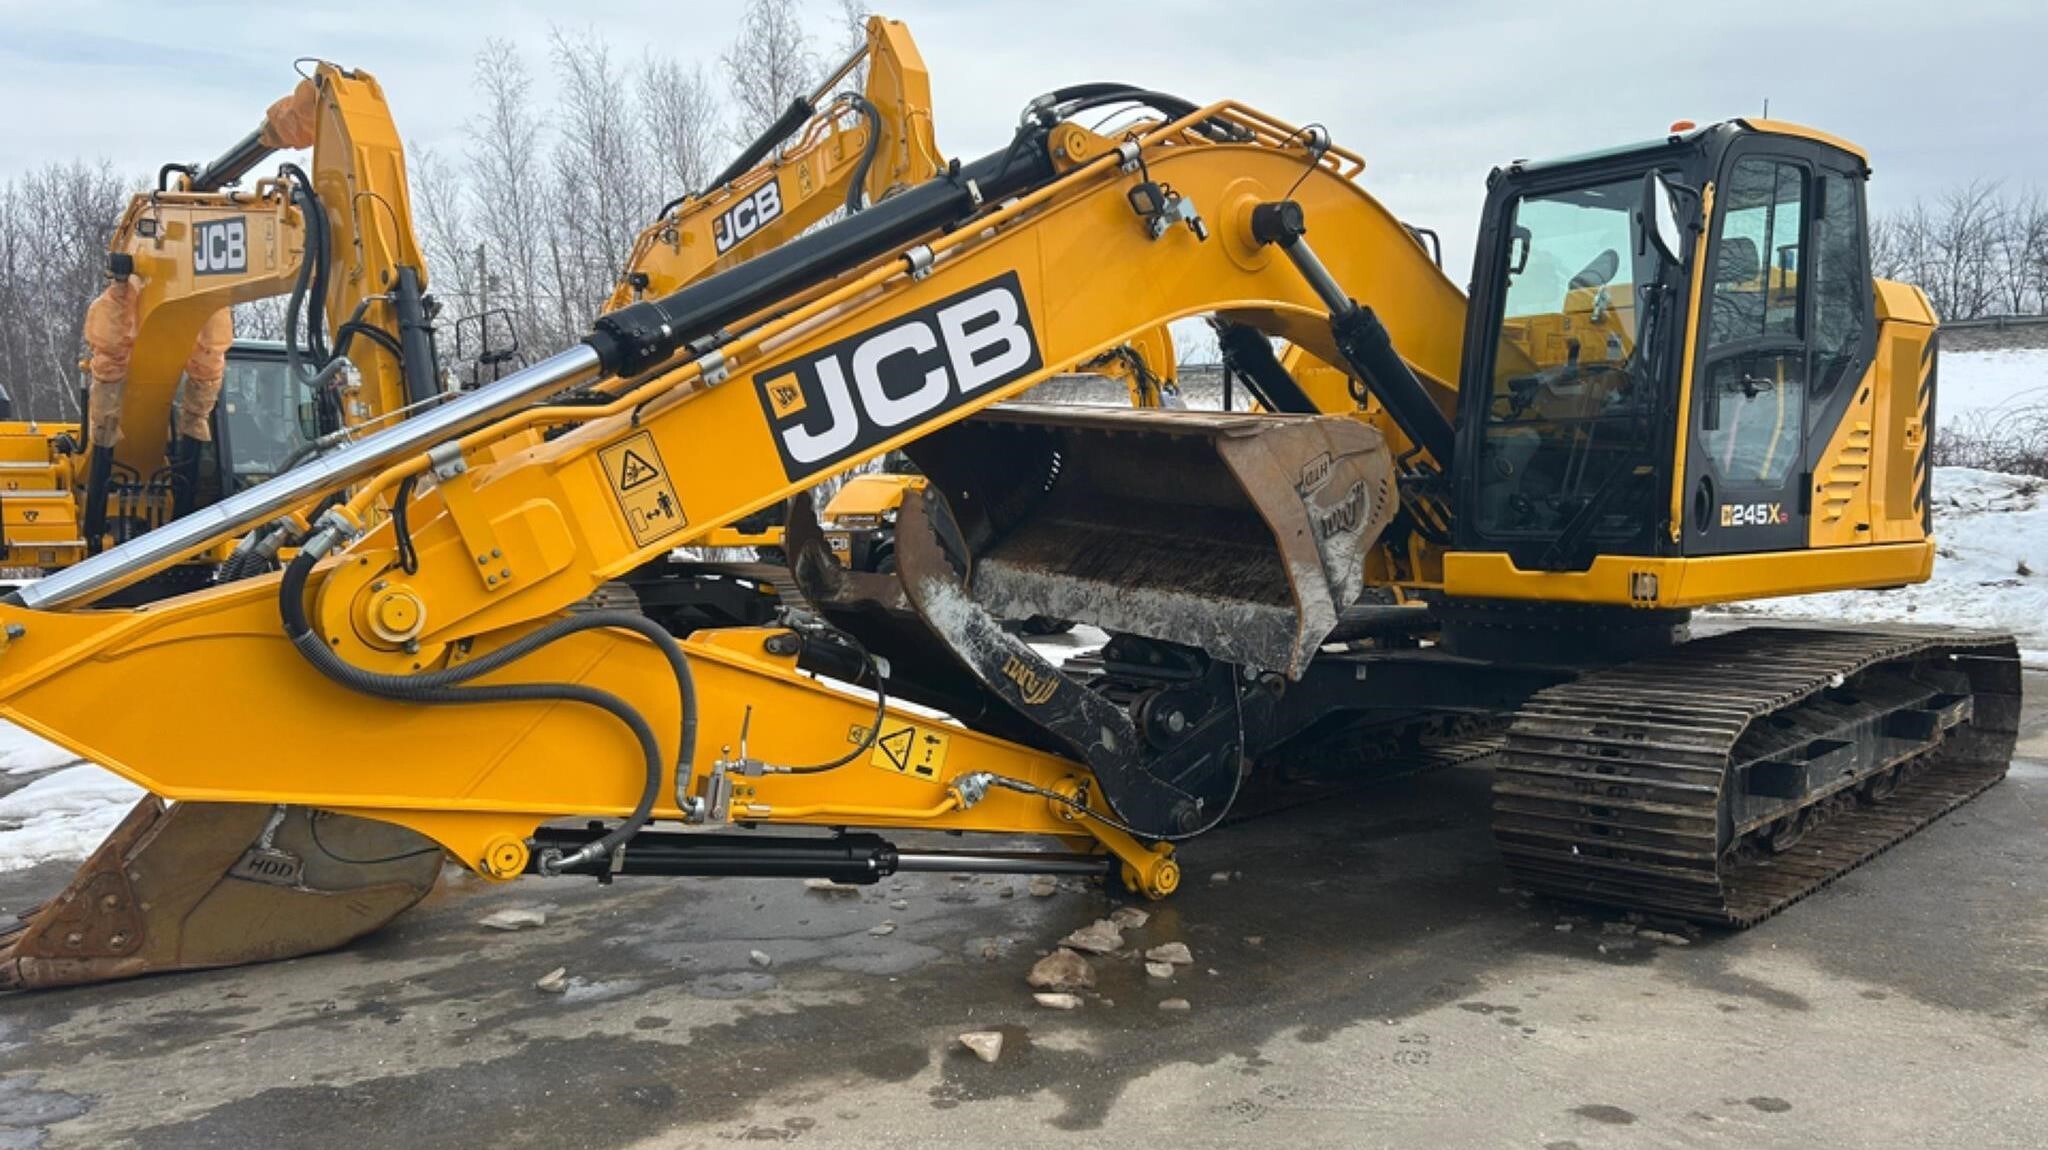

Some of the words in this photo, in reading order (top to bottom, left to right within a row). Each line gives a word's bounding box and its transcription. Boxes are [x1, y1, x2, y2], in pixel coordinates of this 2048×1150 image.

[194, 222, 246, 271] JCB
[717, 182, 782, 252] JCB
[782, 287, 1031, 463] JCB
[248, 858, 294, 877] HDD
